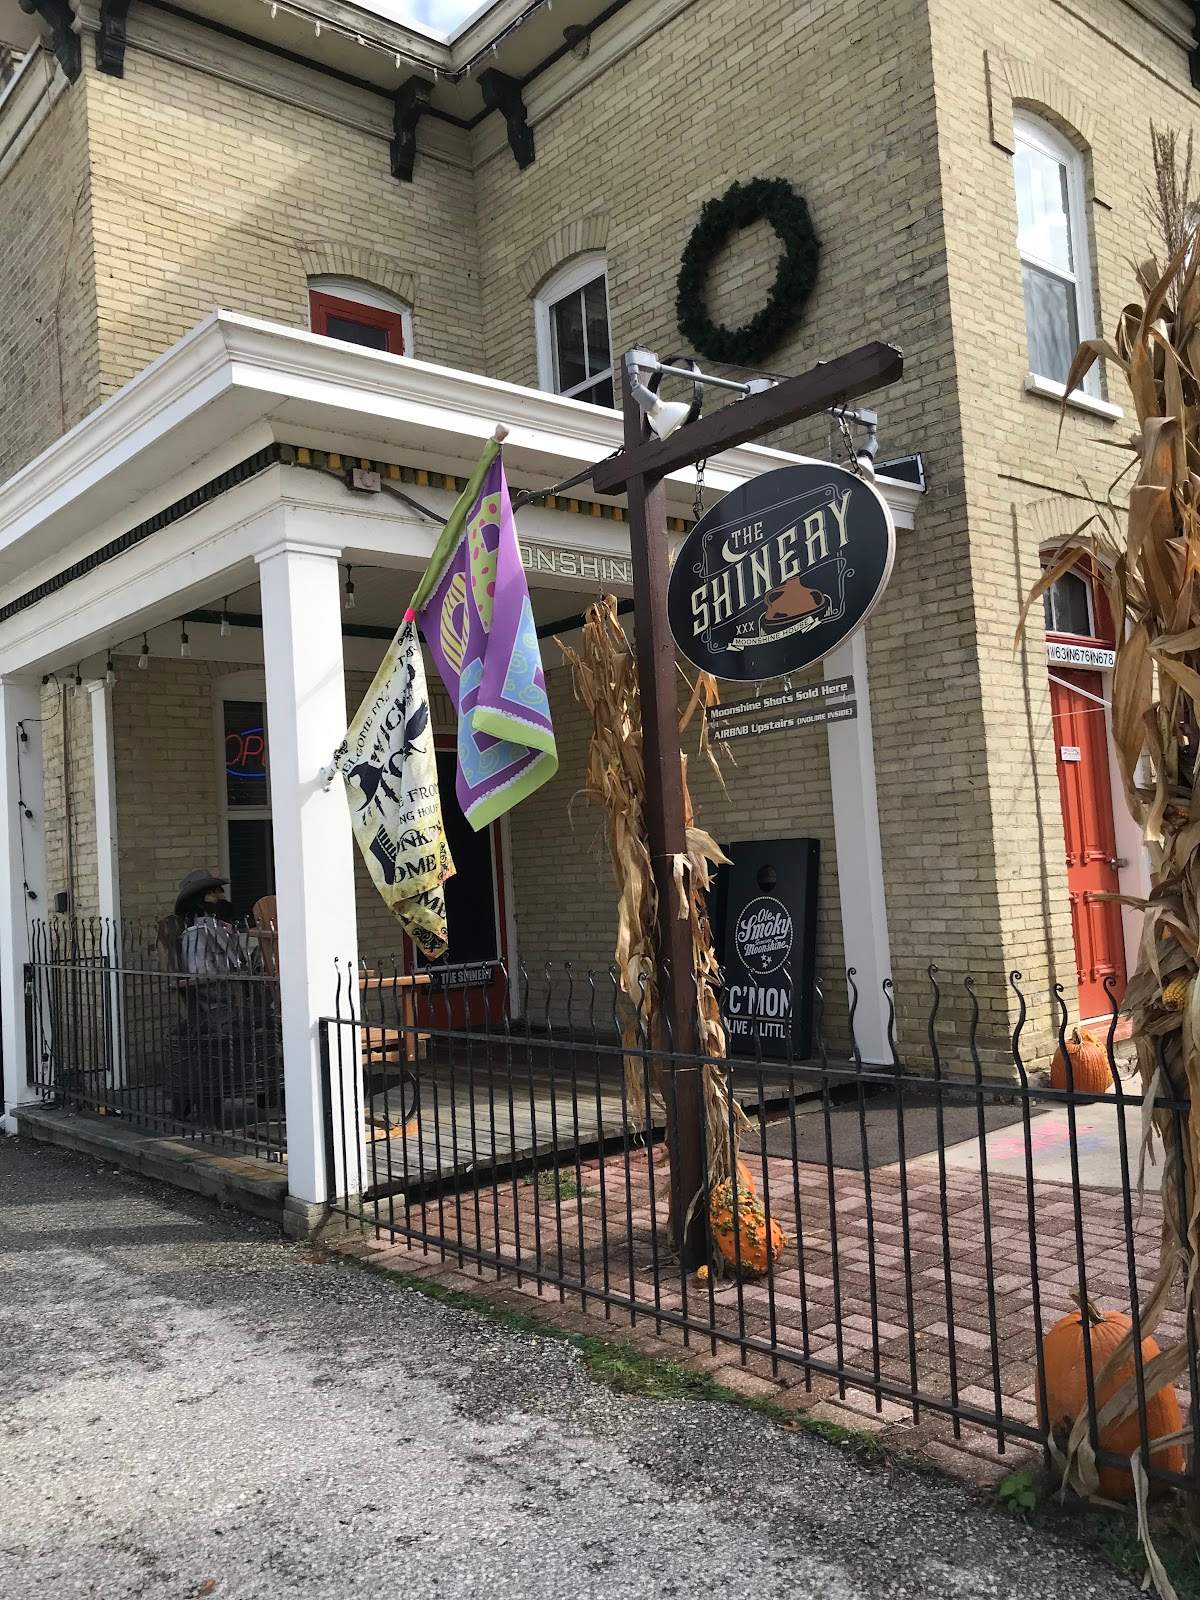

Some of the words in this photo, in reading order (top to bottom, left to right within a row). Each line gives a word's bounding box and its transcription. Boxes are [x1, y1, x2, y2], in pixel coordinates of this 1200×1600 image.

[731, 521, 764, 549] THE
[519, 545, 633, 582] ONSHIN
[690, 491, 851, 636] SHINERY
[735, 620, 755, 636] XXX
[735, 632, 780, 645] MOONSHINE
[781, 619, 810, 637] HOUSE
[1069, 648, 1091, 663] N676
[1093, 651, 1114, 666] N678
[710, 701, 762, 719] Moonshine
[763, 693, 794, 708] Shots
[796, 687, 819, 701] Sold
[821, 682, 848, 697] Here
[713, 725, 749, 740] AIRBNB
[751, 718, 795, 734] Upstairs
[738, 912, 792, 943] Smoky
[758, 908, 776, 922] Ole
[743, 939, 789, 957] Moonshine
[729, 984, 793, 1018] C'MON
[759, 1021, 792, 1040] LITTL
